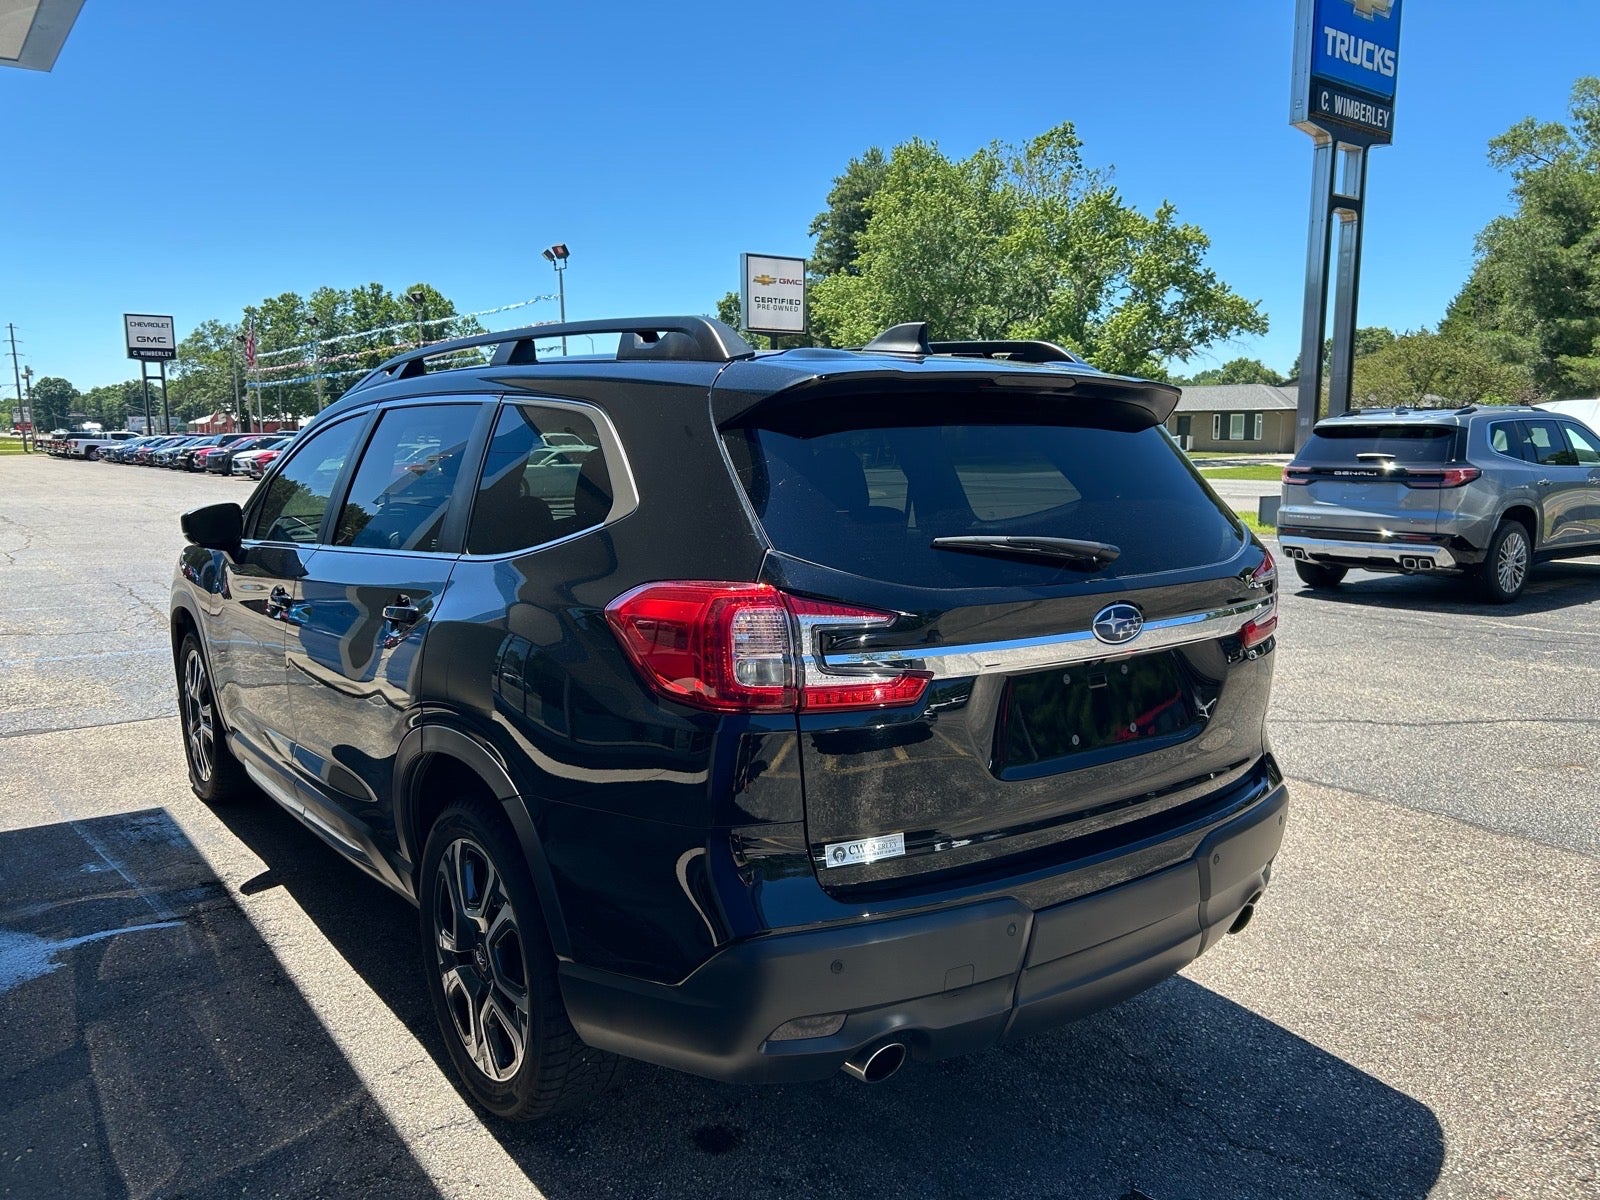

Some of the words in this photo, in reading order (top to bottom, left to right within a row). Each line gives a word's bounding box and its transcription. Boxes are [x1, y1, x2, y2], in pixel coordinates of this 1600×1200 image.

[1324, 26, 1396, 77] TRUCKS
[1321, 91, 1330, 111] C.
[1334, 94, 1390, 128] WIMBERLEY
[778, 278, 802, 286] GMC
[754, 296, 801, 306] CERTIFIED
[756, 303, 799, 313] PRE-OWNED
[129, 321, 169, 329] CHEVROLET
[136, 335, 167, 344] GMC
